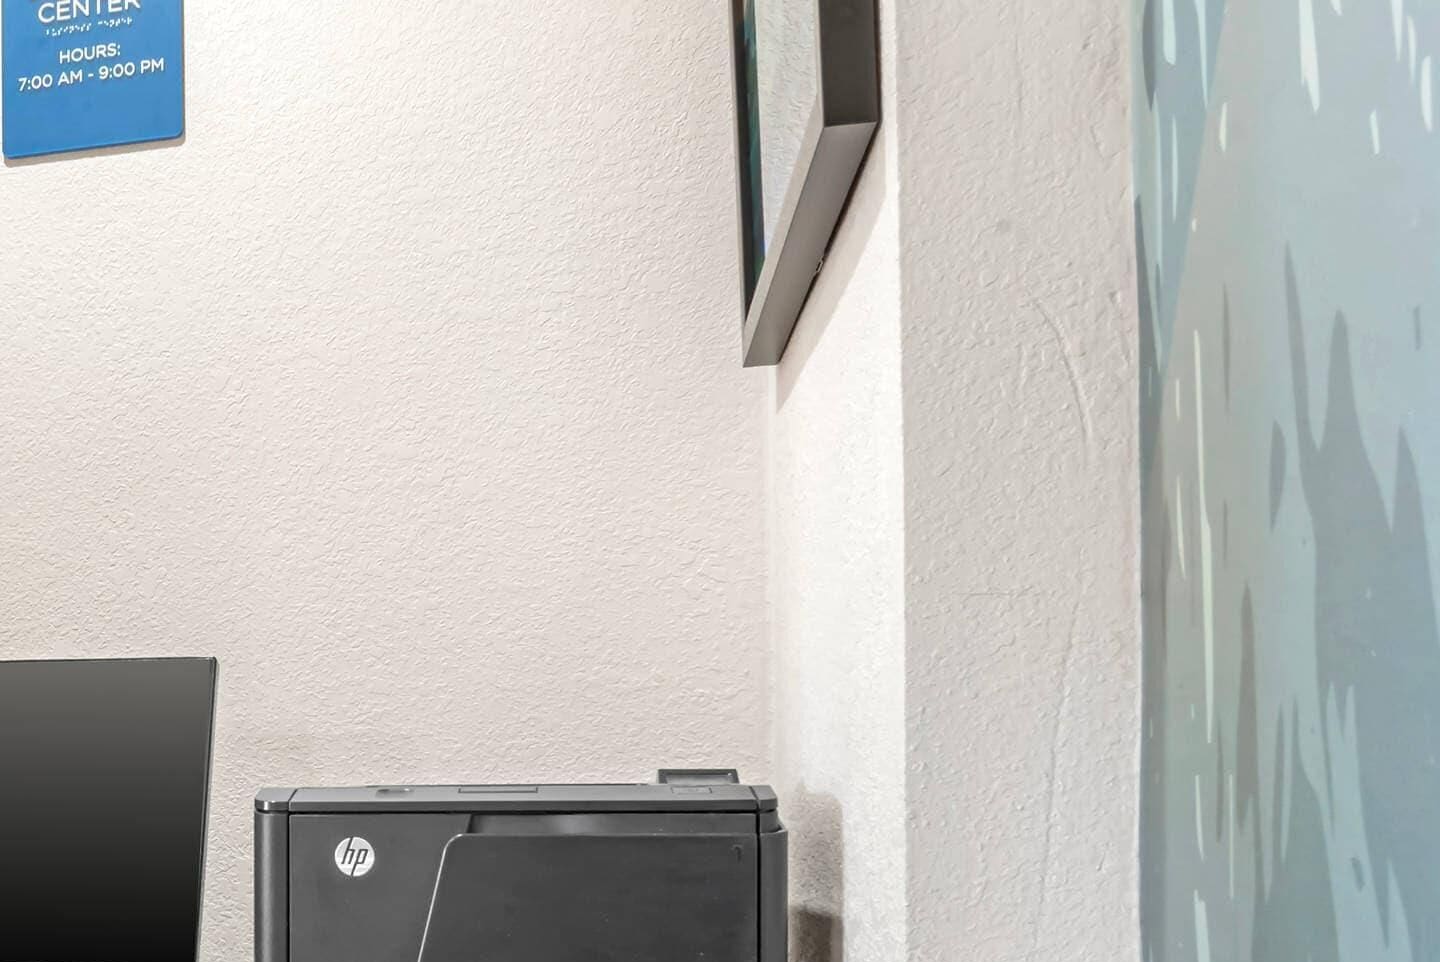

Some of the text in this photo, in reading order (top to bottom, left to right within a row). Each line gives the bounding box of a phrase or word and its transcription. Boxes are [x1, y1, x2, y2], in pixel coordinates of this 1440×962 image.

[59, 43, 121, 64] HOURS:
[18, 74, 53, 91] 7:00
[58, 69, 83, 85] AM
[98, 62, 135, 79] 9:00
[140, 58, 164, 74] PM
[339, 837, 370, 876] hp
